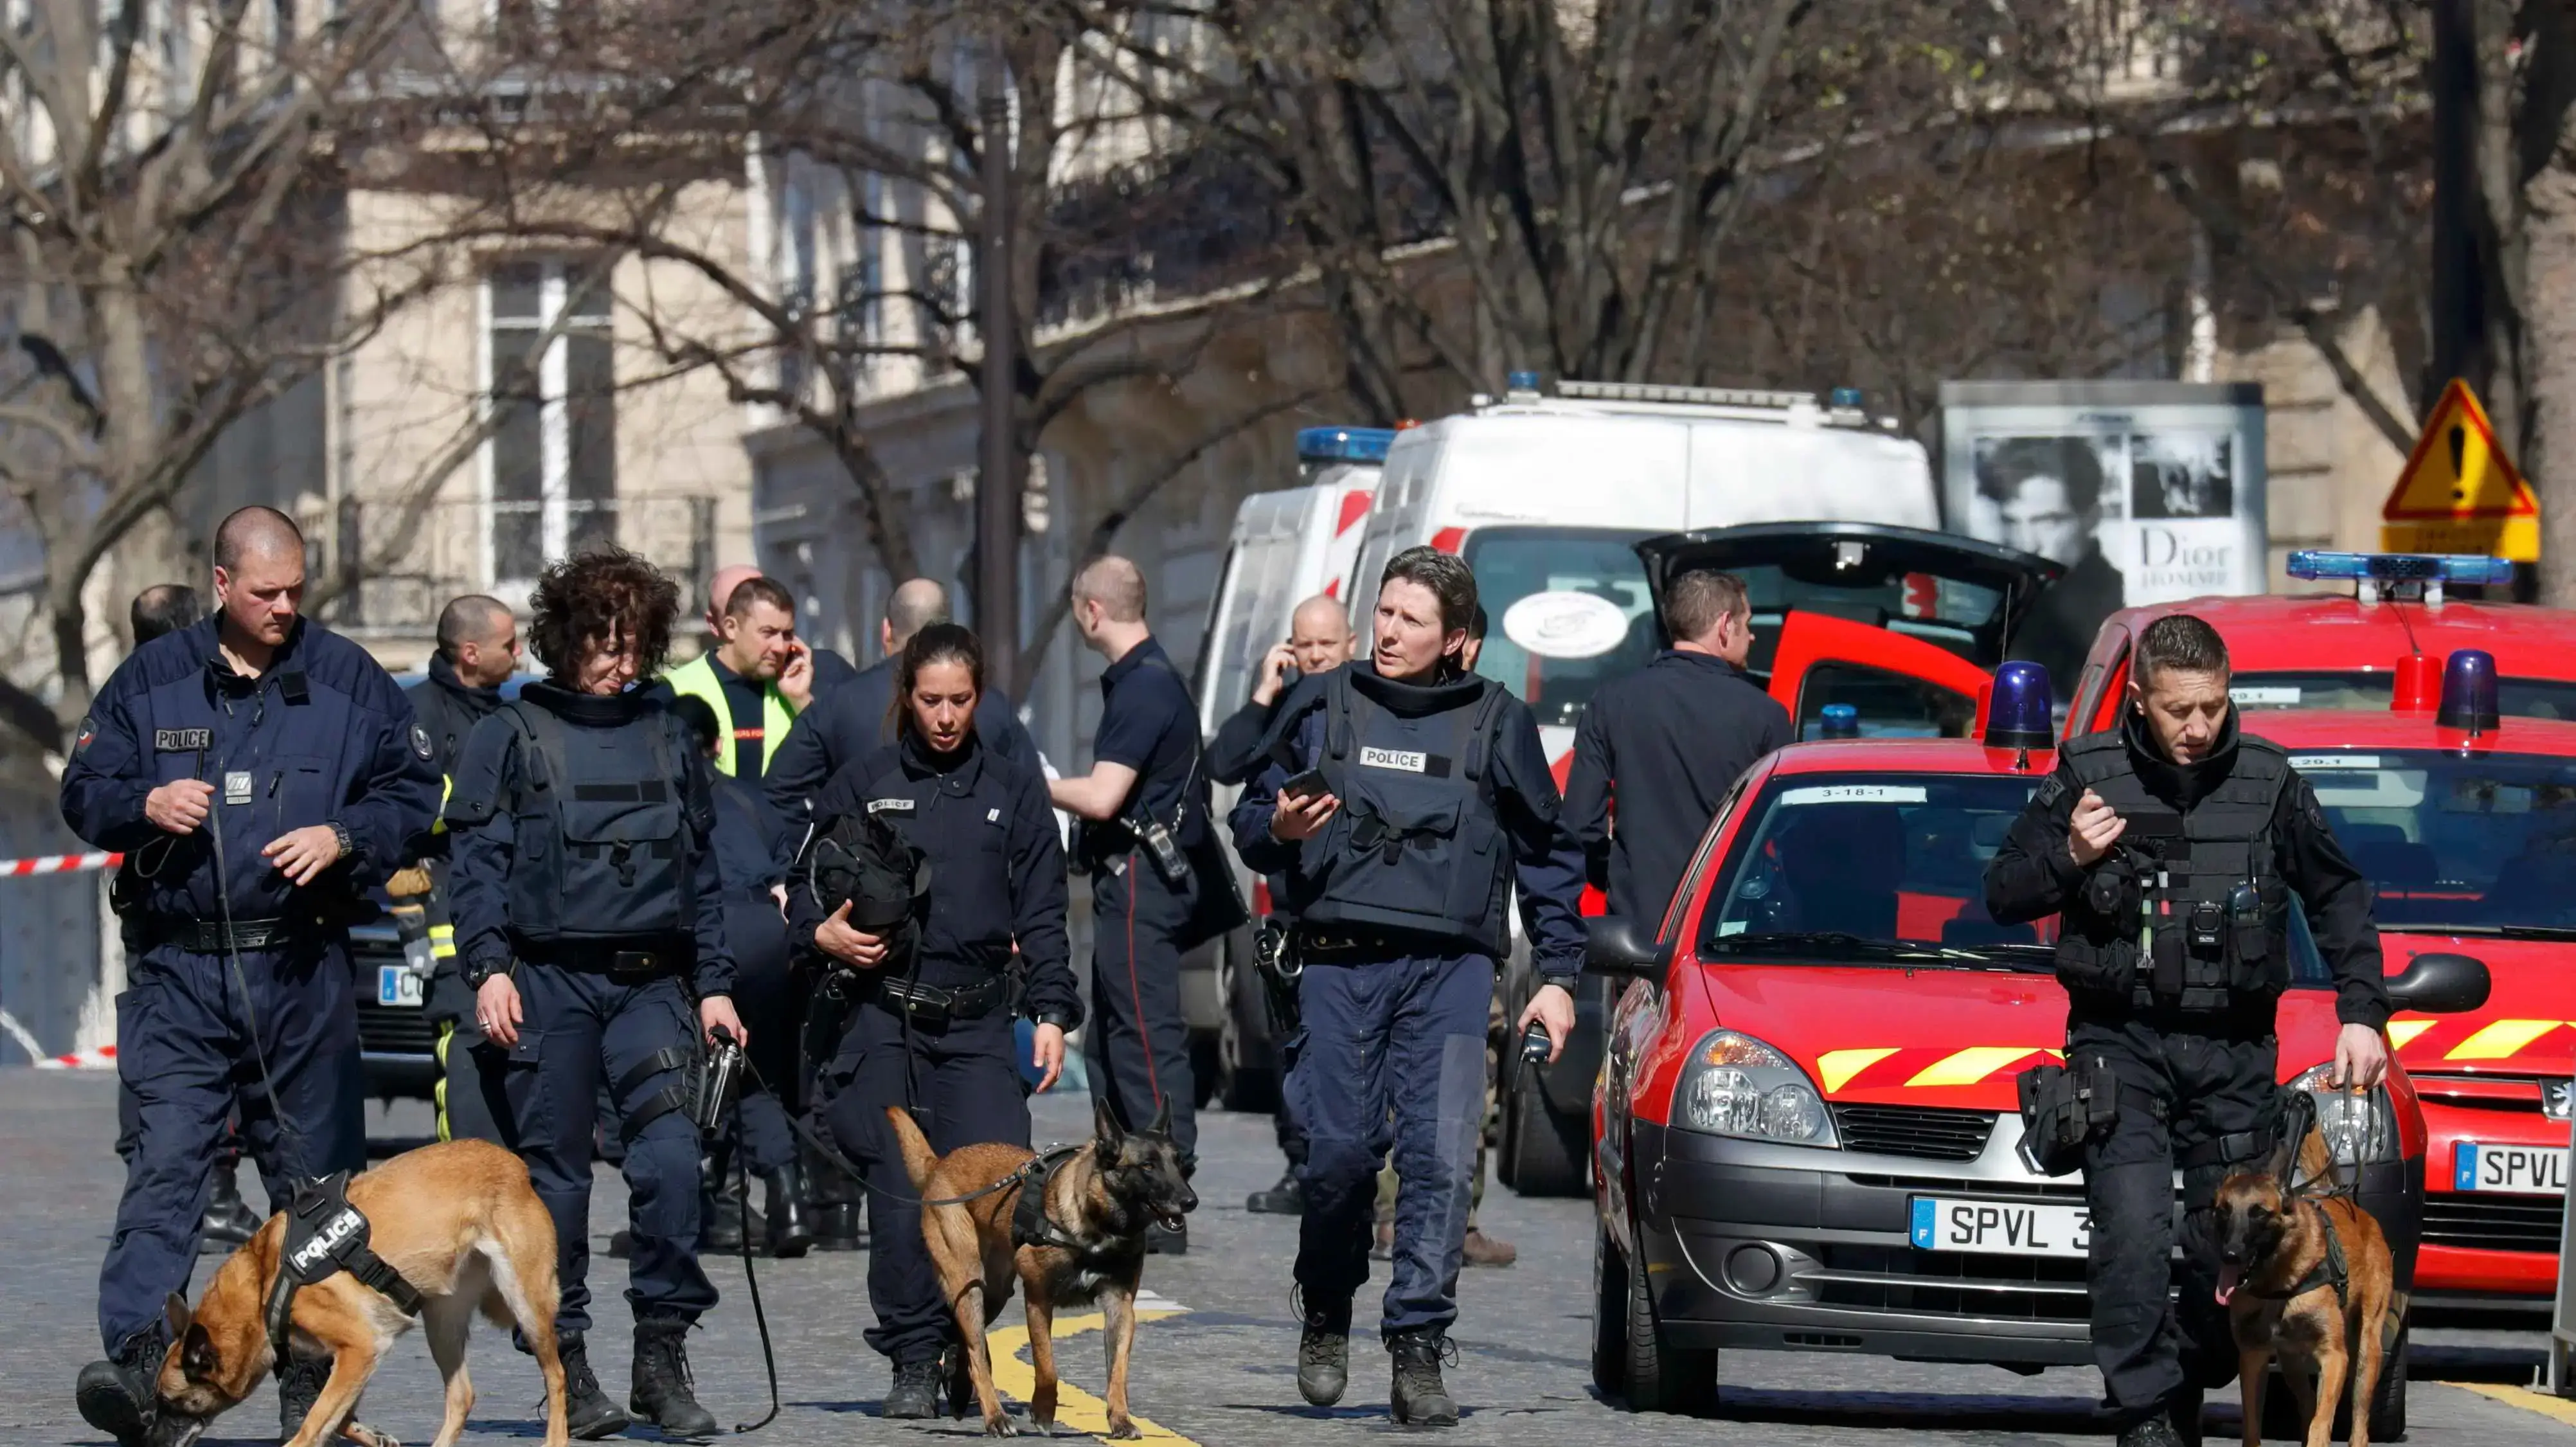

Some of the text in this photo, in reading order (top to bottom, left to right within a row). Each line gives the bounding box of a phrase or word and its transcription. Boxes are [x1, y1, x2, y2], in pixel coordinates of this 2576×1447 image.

[2140, 527, 2232, 567] Dior
[158, 730, 207, 748] POLICE
[1367, 750, 1418, 767] POLICE
[1822, 788, 1884, 796] 3-18-1
[872, 801, 911, 810] POLICE
[2462, 1171, 2471, 1183] F
[2485, 1151, 2566, 1187] SPVL
[1919, 1228, 1928, 1240] F
[1951, 1206, 2048, 1248] SPVL
[294, 1209, 361, 1268] POLICE
